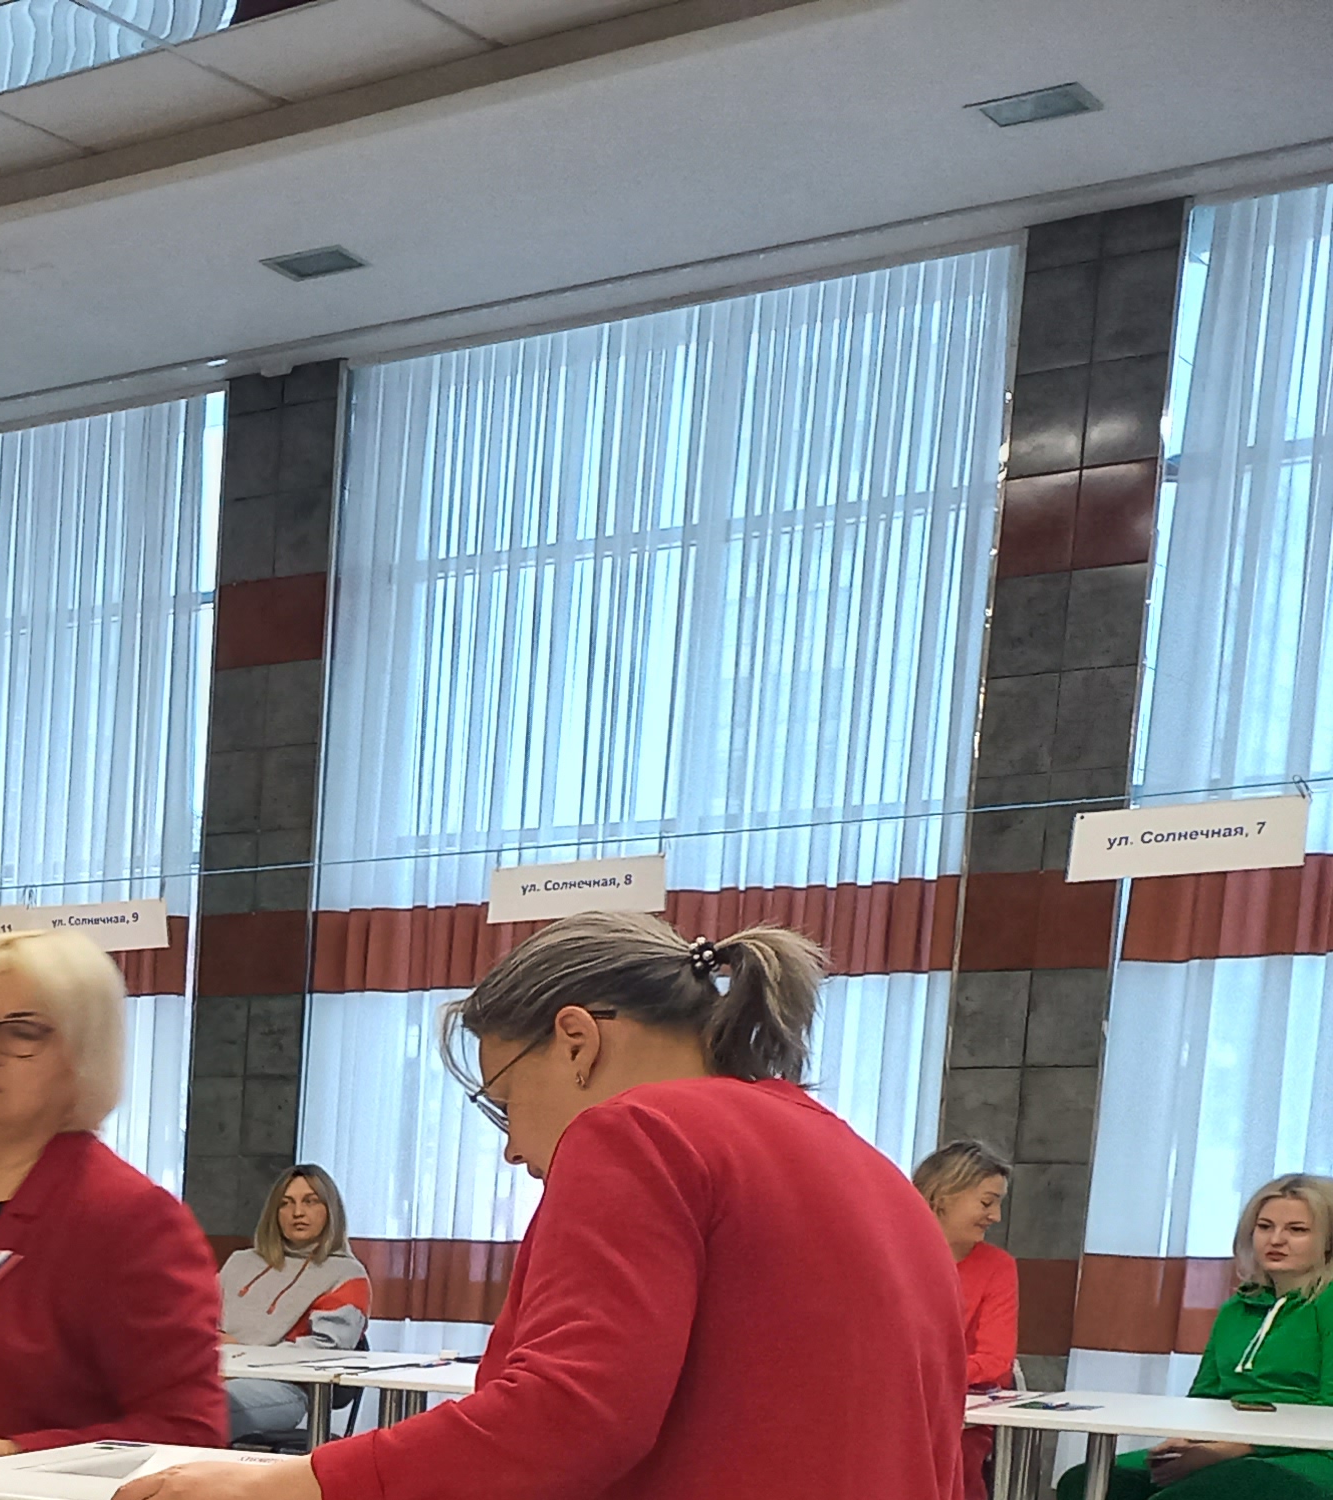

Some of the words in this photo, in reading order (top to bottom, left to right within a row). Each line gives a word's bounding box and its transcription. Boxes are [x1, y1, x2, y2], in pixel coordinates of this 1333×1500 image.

[1106, 834, 1134, 850] ул.
[1140, 822, 1249, 845] Солнечная,
[1256, 821, 1267, 835] 7
[521, 882, 540, 896] ул.
[544, 875, 621, 892] Солнечная,
[624, 873, 633, 886] 8
[0, 923, 13, 934] 11
[51, 918, 67, 929] ул.
[68, 914, 130, 926] Солнечная,
[131, 911, 139, 923] 9
